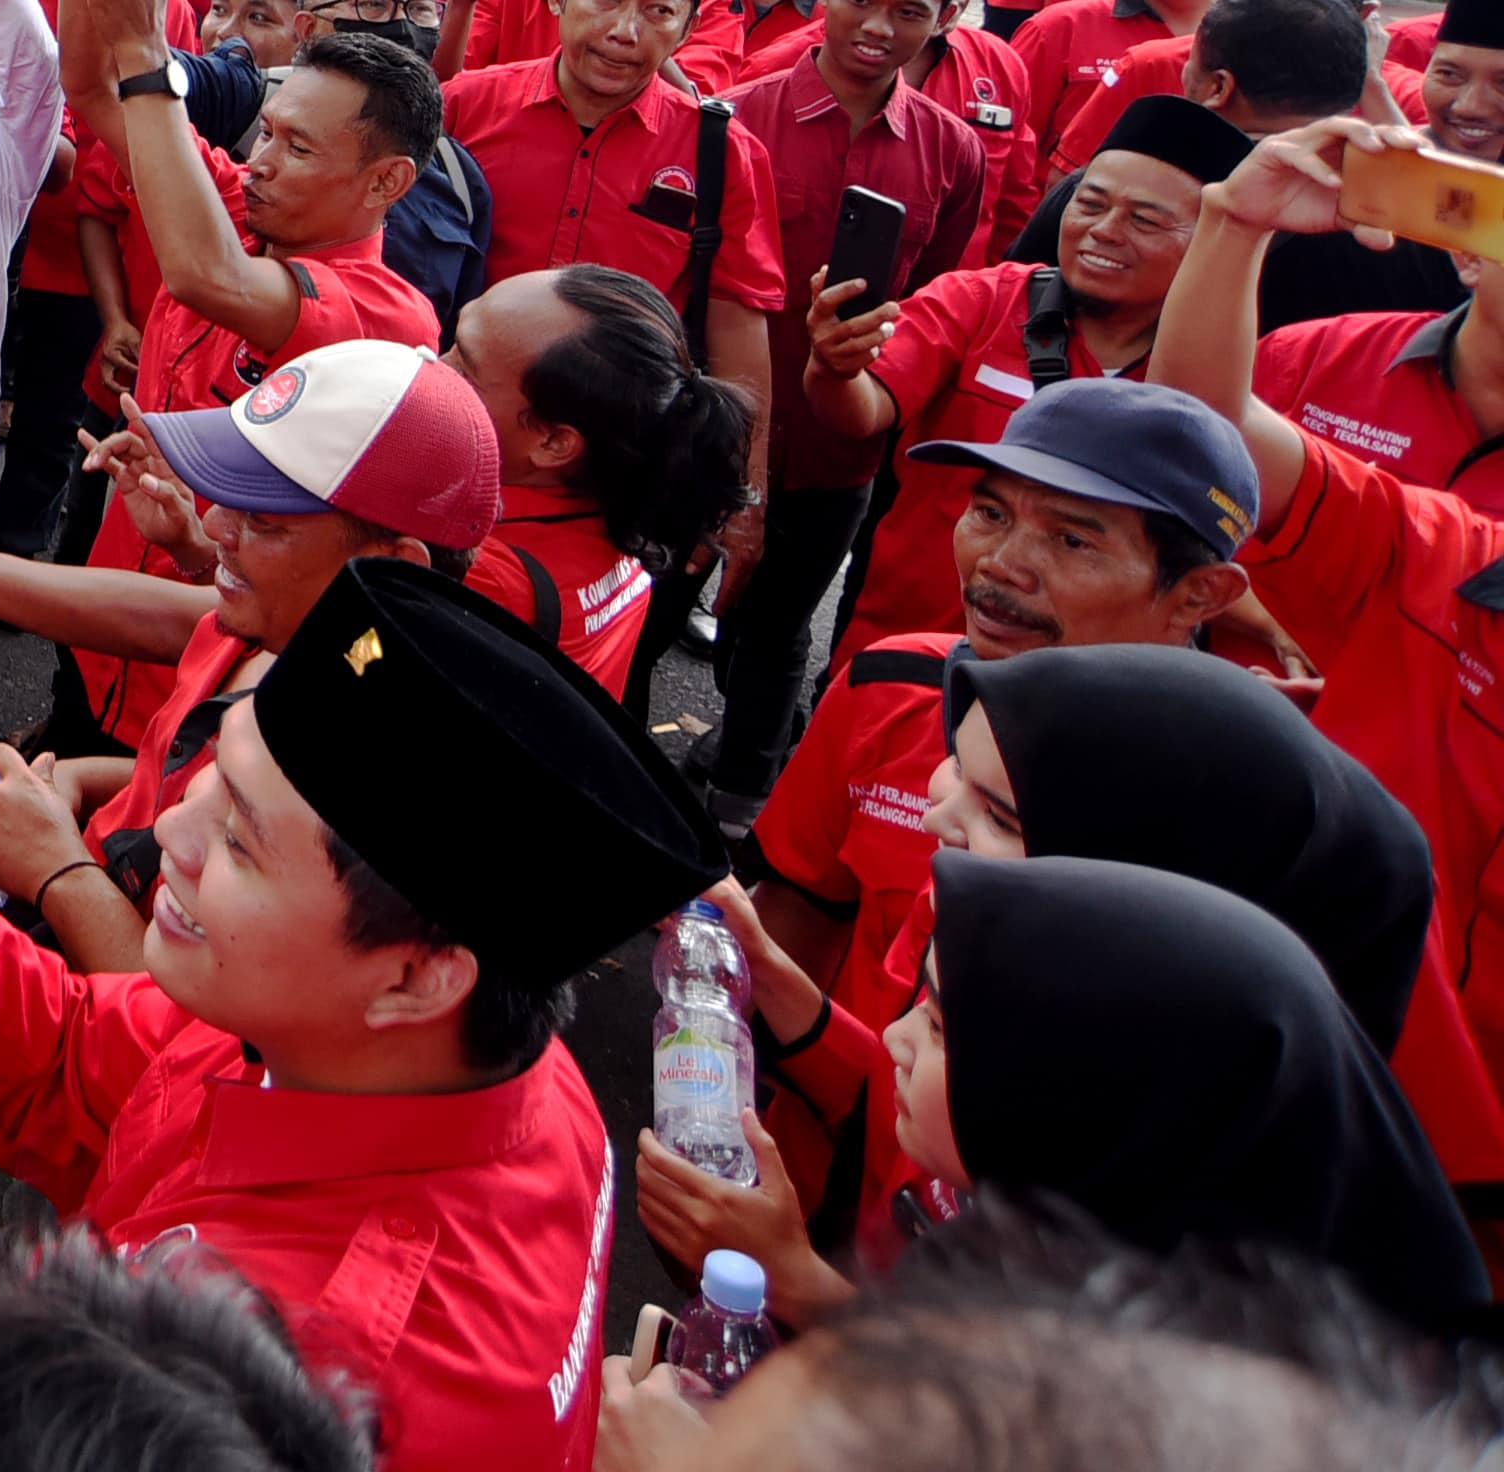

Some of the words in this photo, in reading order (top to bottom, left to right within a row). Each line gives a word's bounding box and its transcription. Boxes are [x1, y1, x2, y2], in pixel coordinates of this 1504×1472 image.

[1301, 414, 1328, 436] KEC.
[1333, 428, 1403, 459] TEGALSARI
[1303, 402, 1359, 431] PENGURUS
[1360, 422, 1411, 448] RANTING
[658, 1068, 722, 1083] Minerale
[677, 1053, 697, 1068] Le
